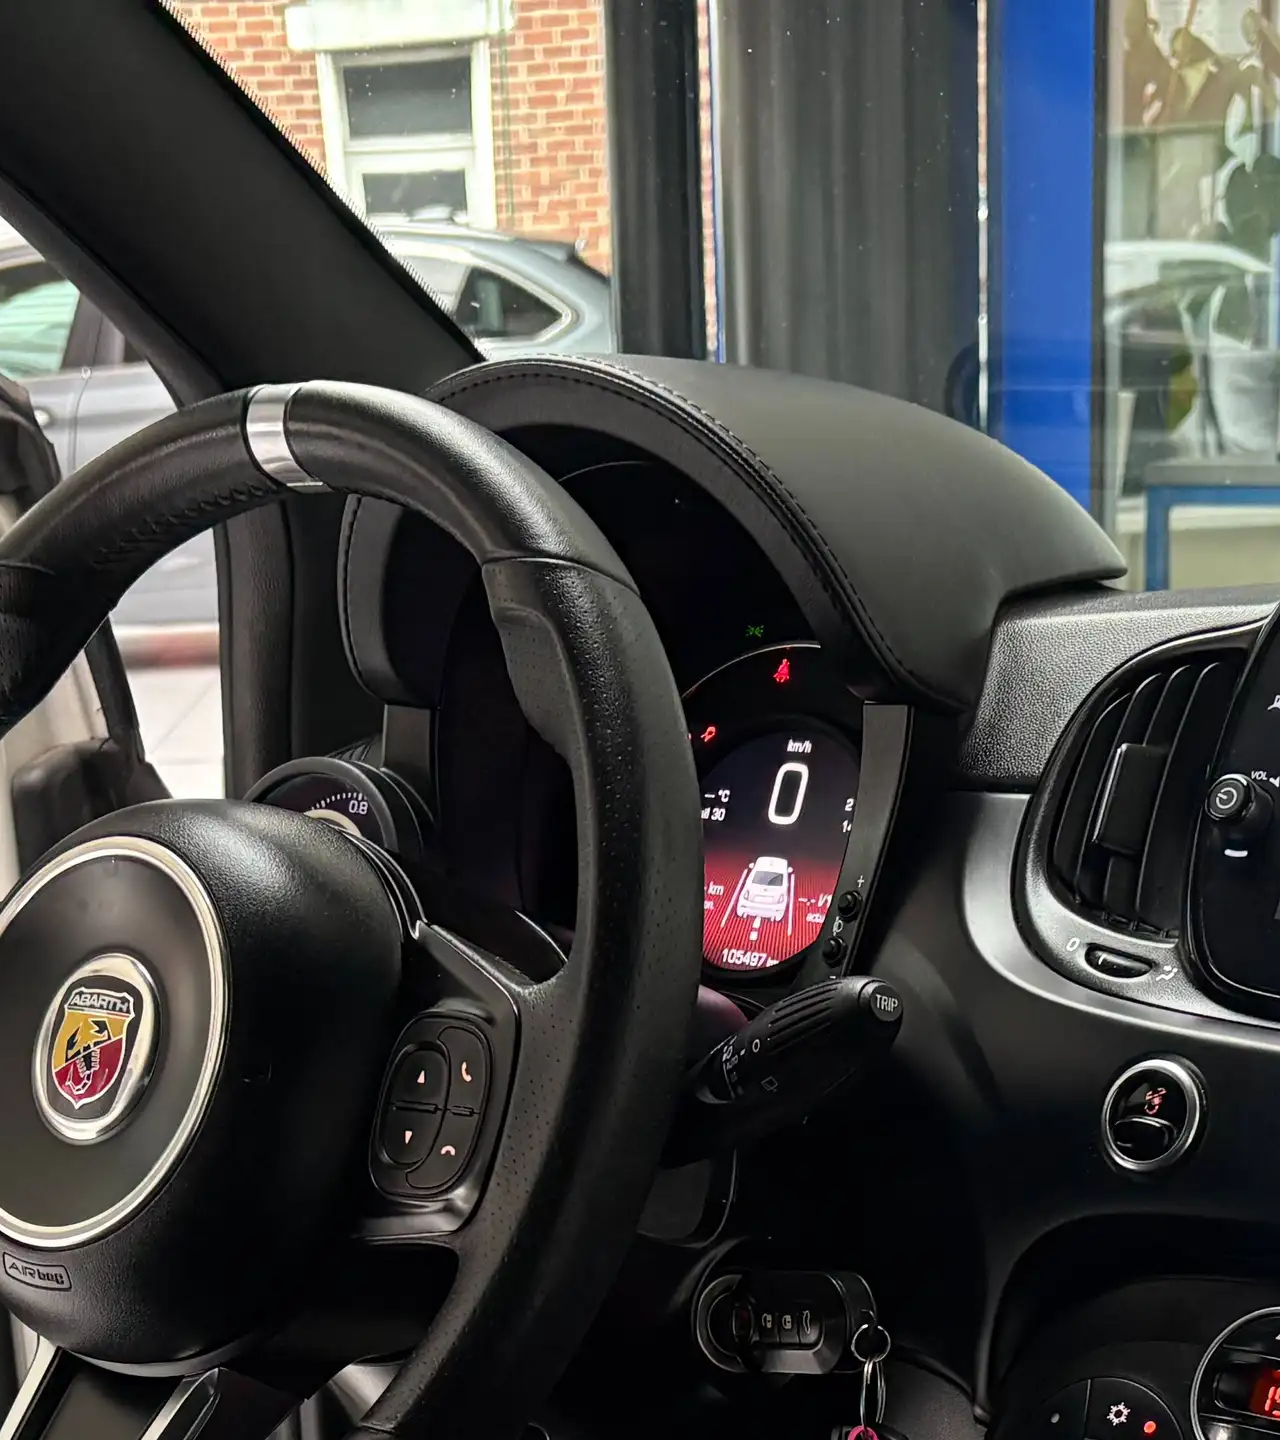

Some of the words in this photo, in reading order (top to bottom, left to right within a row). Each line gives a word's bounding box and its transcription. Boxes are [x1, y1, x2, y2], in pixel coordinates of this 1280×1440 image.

[787, 739, 813, 754] km/h
[1250, 770, 1268, 781] VOL
[768, 762, 809, 825] 0
[348, 799, 369, 815] 0.8
[711, 808, 726, 821] 30
[708, 881, 724, 896] km
[722, 948, 767, 967] 105497
[70, 993, 129, 1013] ABARTH
[875, 993, 899, 1013] TRIP
